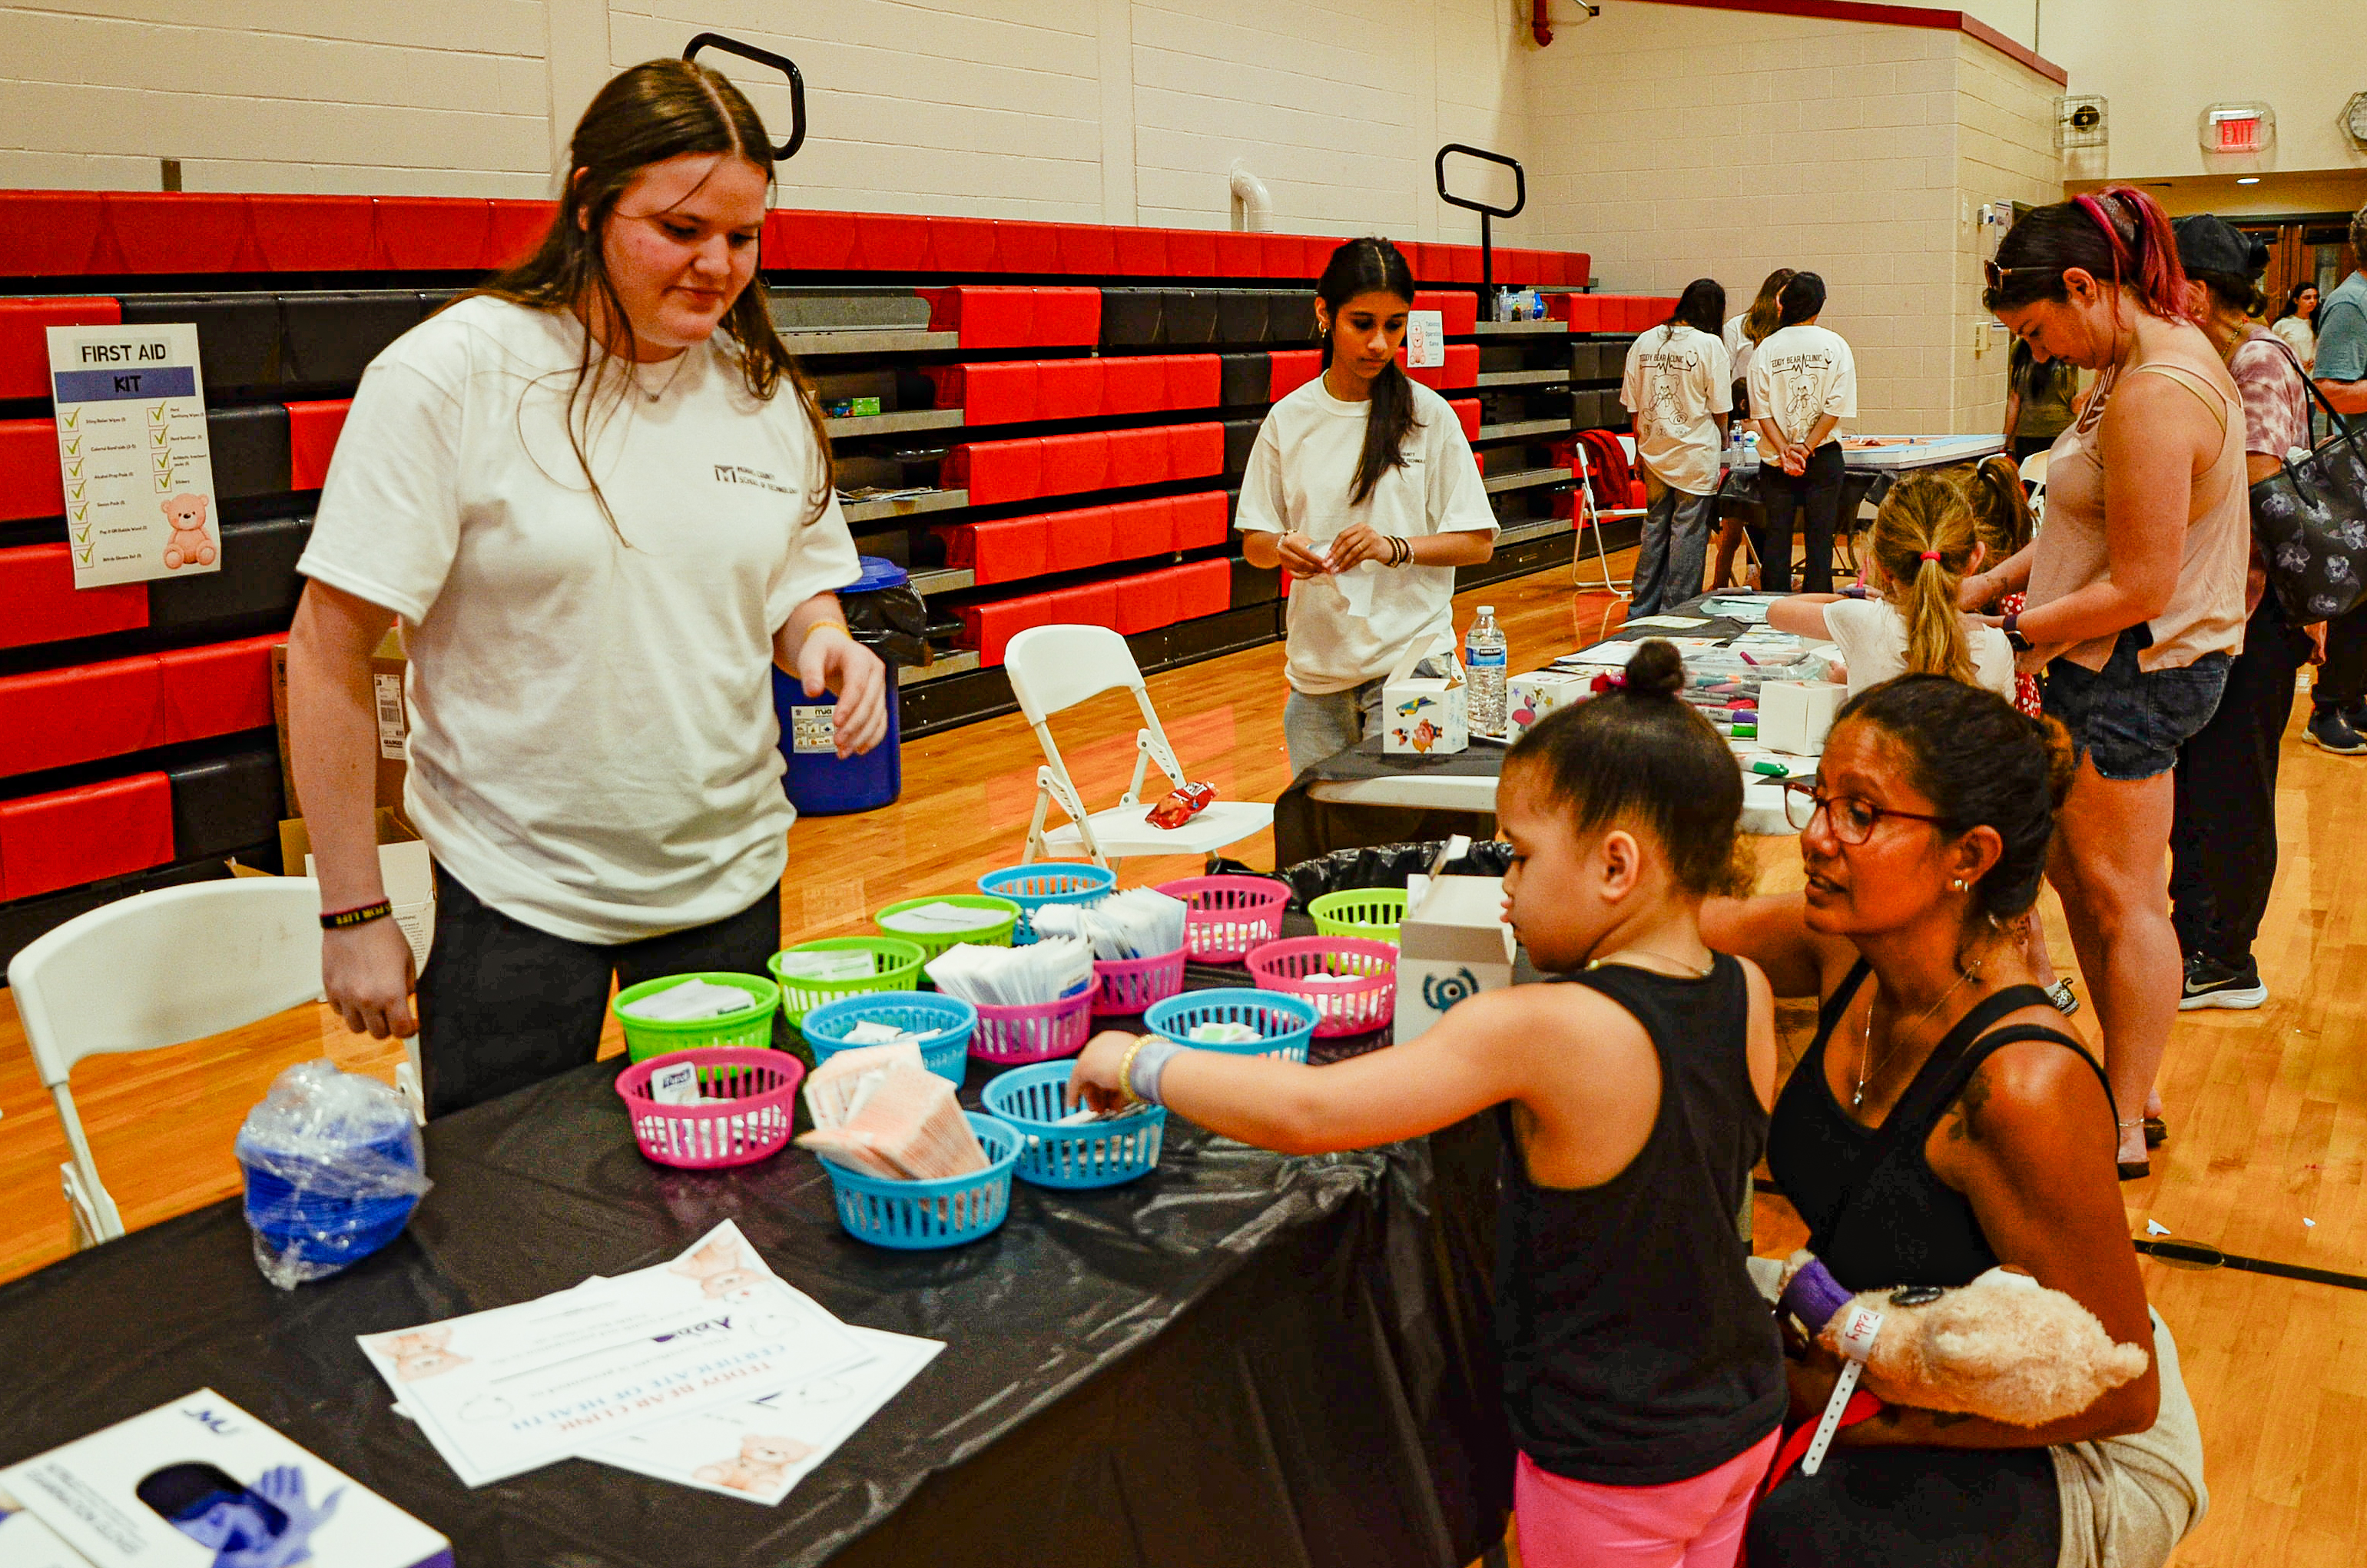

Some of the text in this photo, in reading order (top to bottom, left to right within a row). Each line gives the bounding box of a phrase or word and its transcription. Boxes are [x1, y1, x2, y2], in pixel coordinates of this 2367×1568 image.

[2222, 119, 2256, 145] EXIT
[81, 343, 167, 363] FIRST AID
[1653, 353, 1666, 362] BEAR
[1669, 354, 1685, 363] CLINIC
[1786, 355, 1802, 364] BEAR
[114, 375, 142, 393] KIT
[1845, 1313, 1880, 1341] Teddy
[636, 1384, 695, 1409] BEAR
